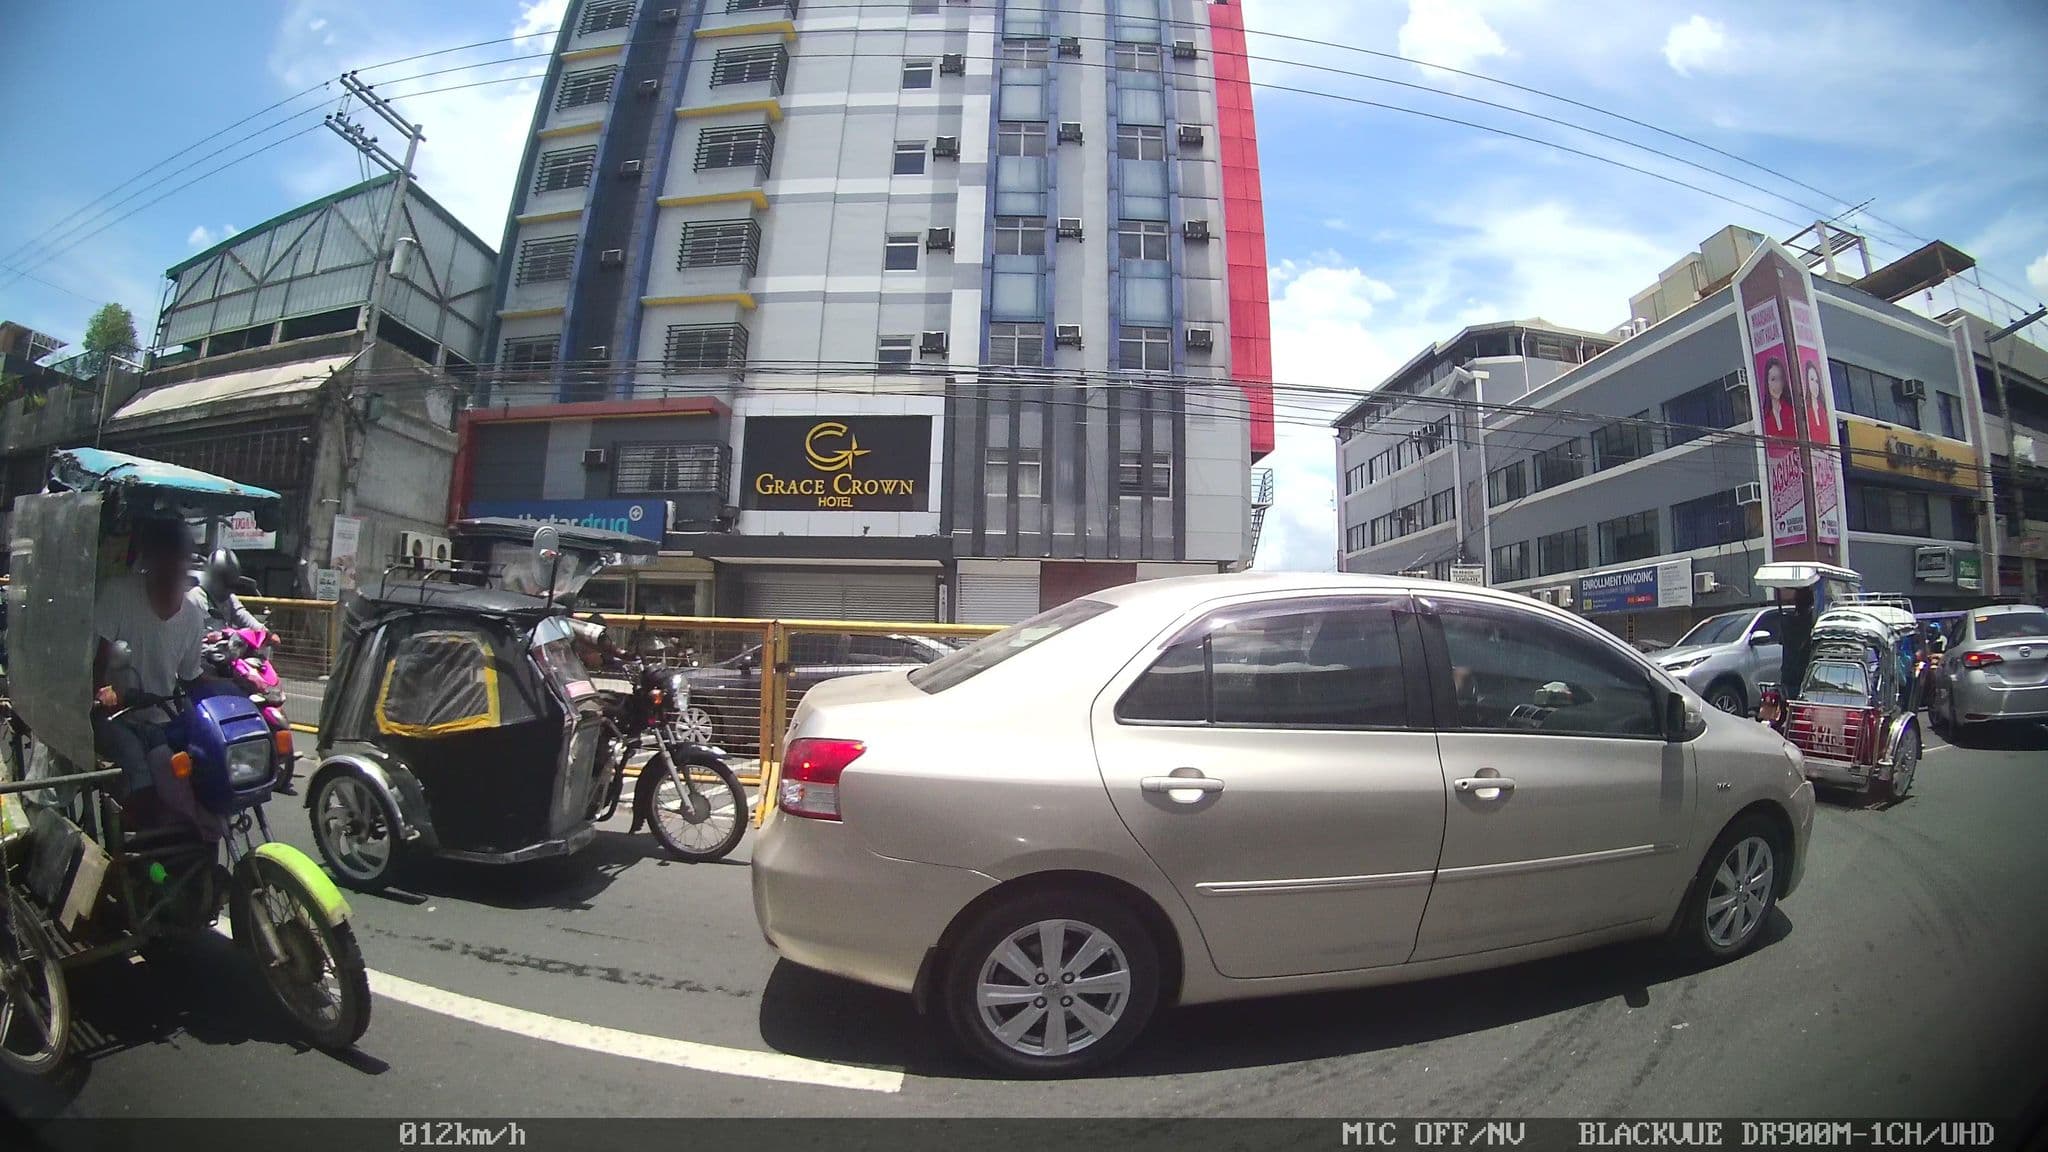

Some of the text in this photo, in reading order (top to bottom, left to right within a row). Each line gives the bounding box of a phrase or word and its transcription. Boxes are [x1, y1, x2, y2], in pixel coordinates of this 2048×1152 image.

[755, 473, 914, 495] GRACE CROWN
[818, 496, 853, 508] HOTEL
[1582, 574, 1622, 591] ENROLLMENT
[1623, 570, 1654, 585] ONGOING
